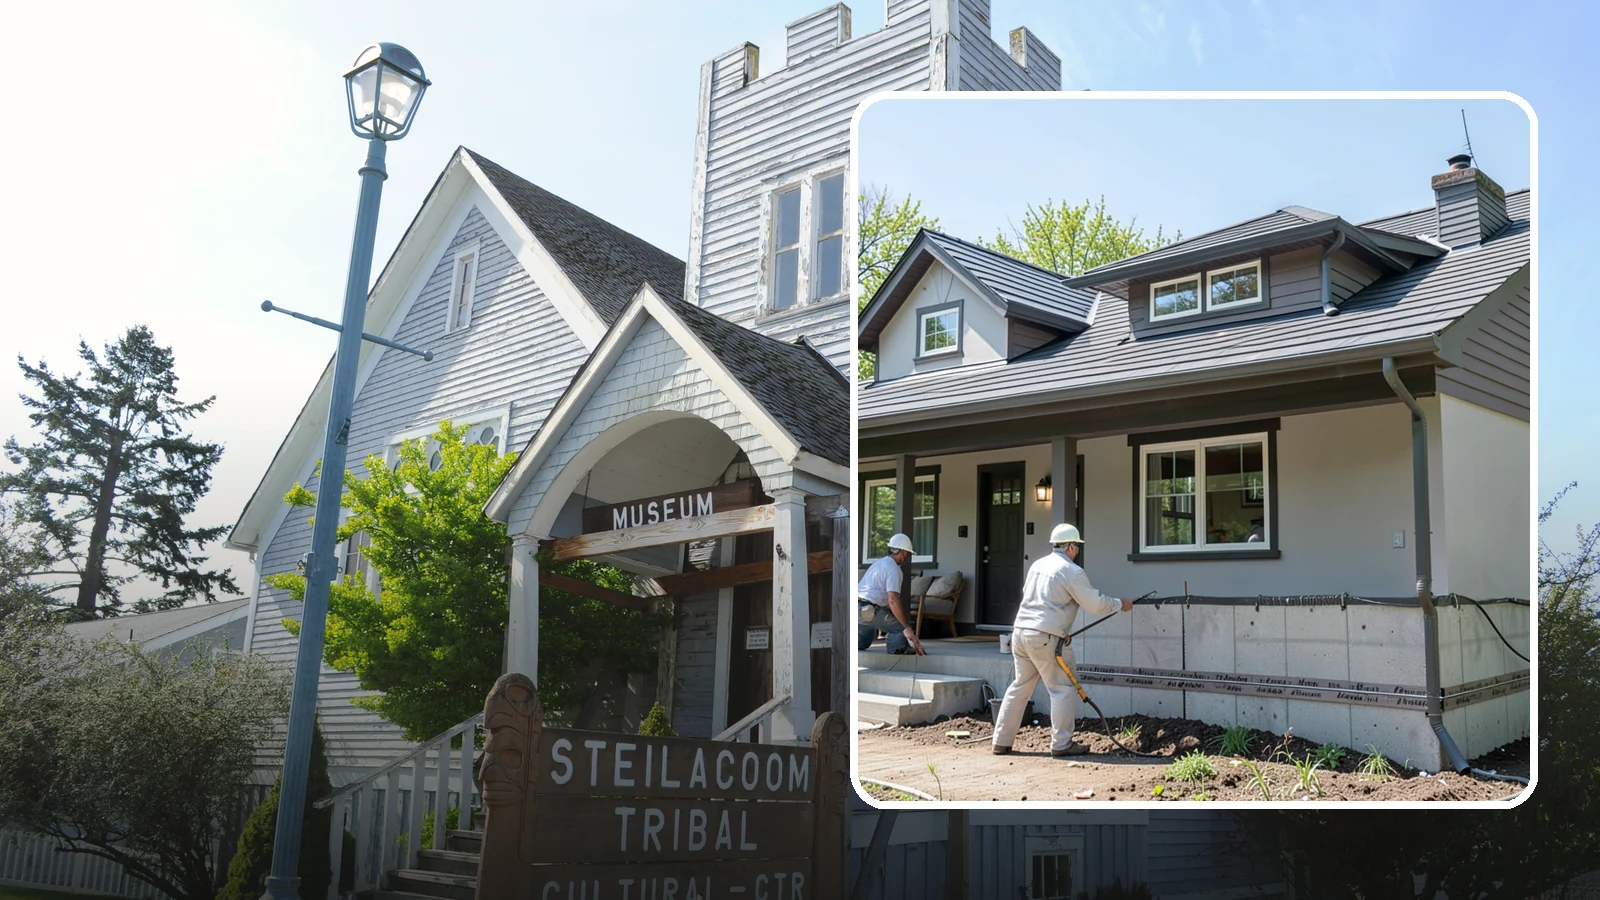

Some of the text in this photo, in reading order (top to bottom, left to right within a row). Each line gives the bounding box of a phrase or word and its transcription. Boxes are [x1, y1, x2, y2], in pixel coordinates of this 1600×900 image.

[612, 491, 714, 531] MUSEUM
[550, 737, 809, 793] STEILACOOM
[614, 806, 758, 852] TRIBAL
